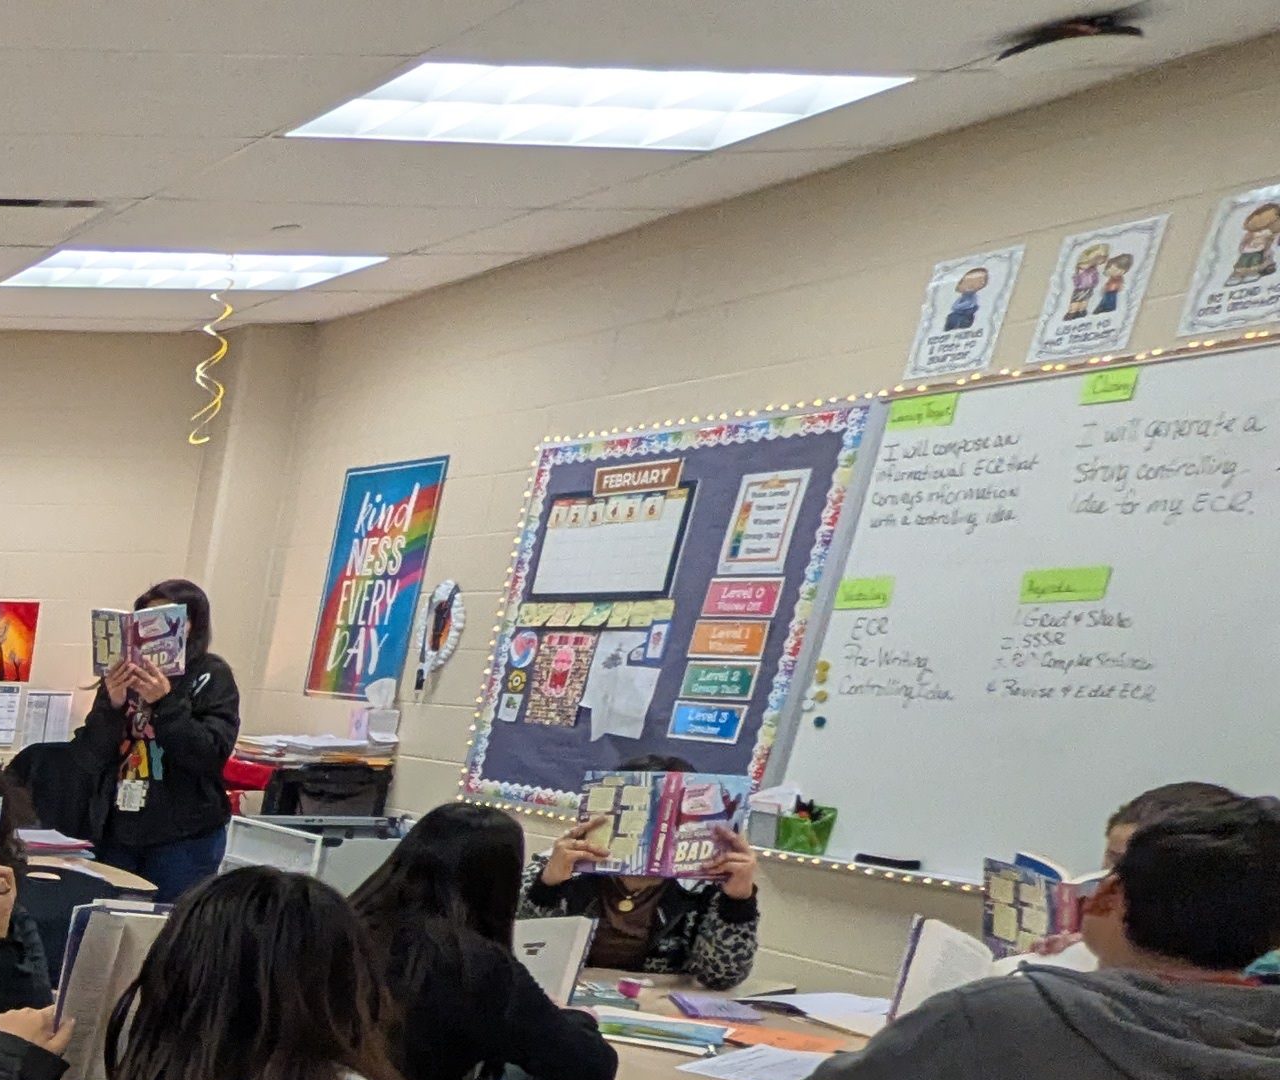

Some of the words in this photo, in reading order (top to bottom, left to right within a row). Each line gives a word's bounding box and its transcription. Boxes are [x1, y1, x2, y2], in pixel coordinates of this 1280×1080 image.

[1144, 411, 1237, 452] generate
[602, 468, 672, 489] FEBRUARY
[354, 482, 421, 537] kind
[571, 512, 579, 523] 2
[346, 535, 406, 576] NESS
[335, 579, 401, 626] EVERY
[720, 587, 753, 599] Level
[326, 628, 390, 675] DAY
[697, 670, 730, 681] Level
[687, 709, 718, 722] Level
[674, 840, 714, 864] BAD
